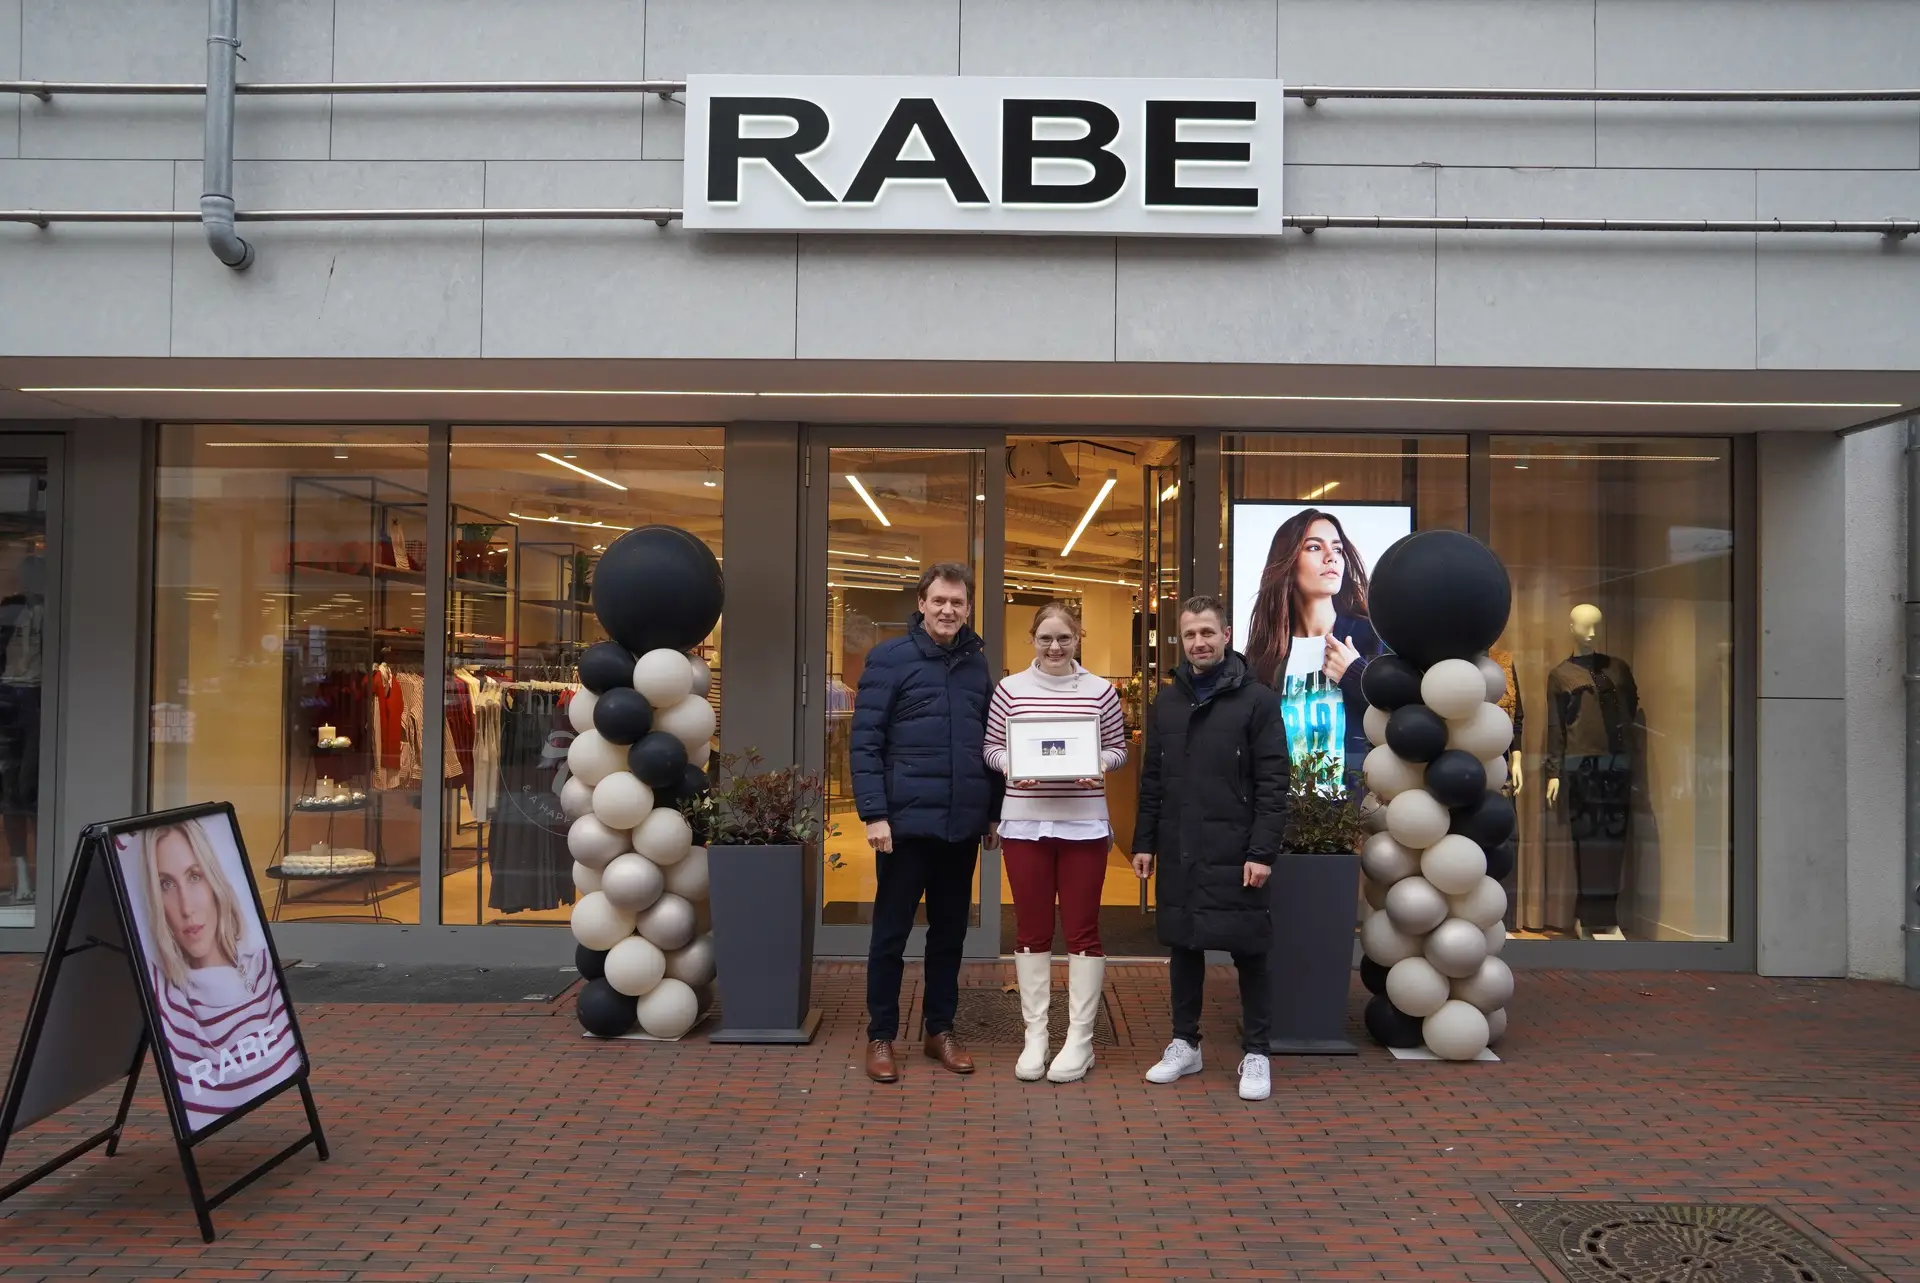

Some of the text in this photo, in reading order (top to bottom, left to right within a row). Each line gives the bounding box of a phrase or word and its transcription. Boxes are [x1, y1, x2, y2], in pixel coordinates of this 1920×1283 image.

[707, 97, 1258, 207] RABE
[502, 684, 569, 716] Chri
[539, 803, 571, 823] HAPP
[188, 1023, 282, 1096] RABE
